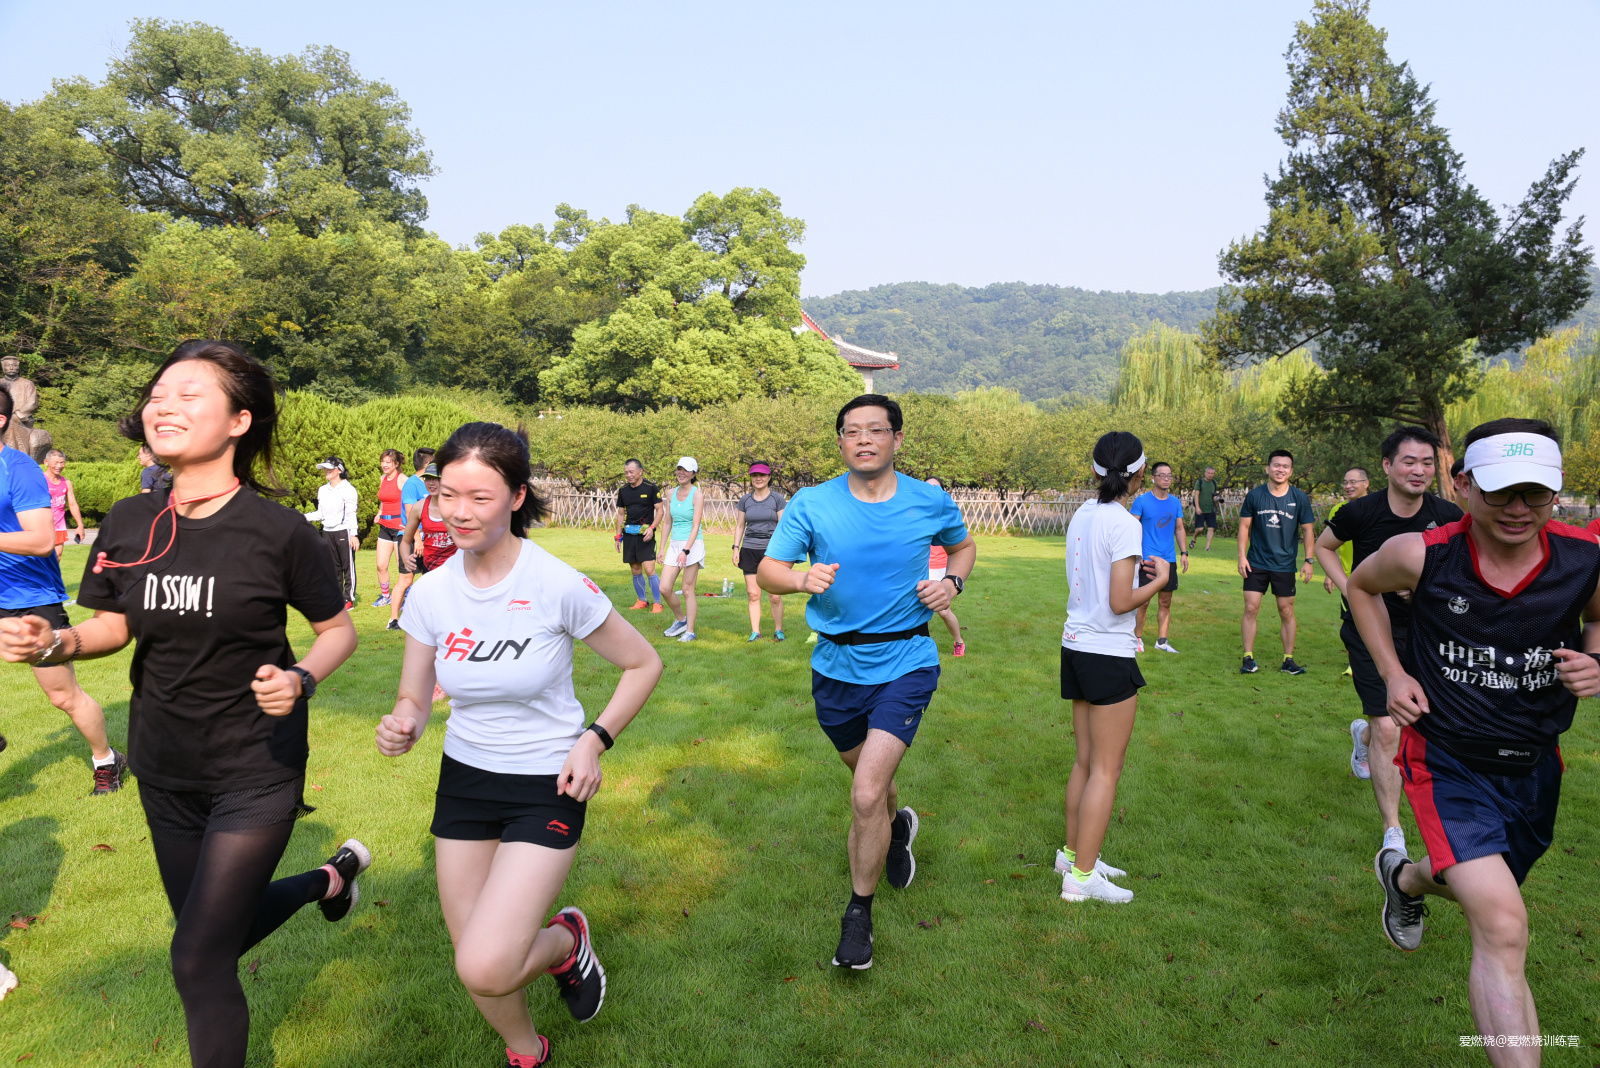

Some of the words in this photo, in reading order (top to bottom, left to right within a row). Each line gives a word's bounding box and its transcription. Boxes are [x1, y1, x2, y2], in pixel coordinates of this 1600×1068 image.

[443, 627, 533, 662] RUN
[1439, 640, 1564, 671] 中国·海
